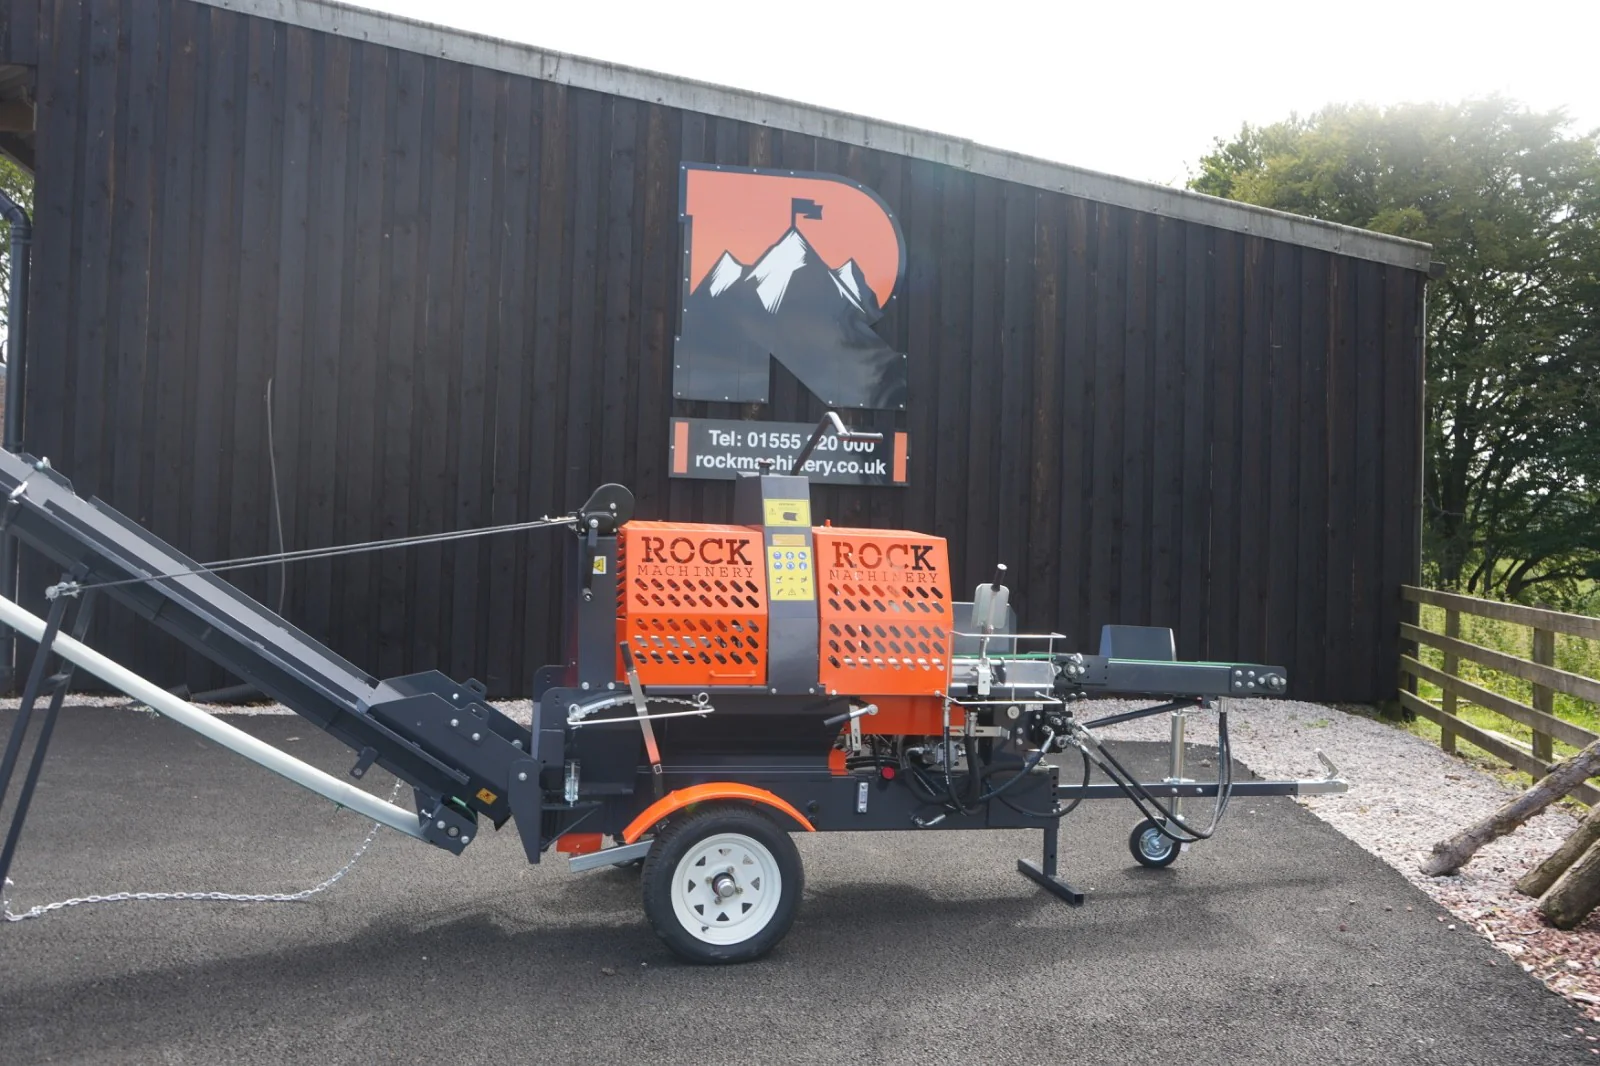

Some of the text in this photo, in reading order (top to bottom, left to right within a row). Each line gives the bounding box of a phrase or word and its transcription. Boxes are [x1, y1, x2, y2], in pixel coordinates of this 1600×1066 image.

[708, 429, 742, 447] Tel:
[747, 431, 801, 449] 01555
[641, 536, 753, 565] ROCK
[831, 541, 936, 571] ROCK
[637, 564, 754, 578] MACHINERY
[829, 569, 939, 584] MACHINERY
